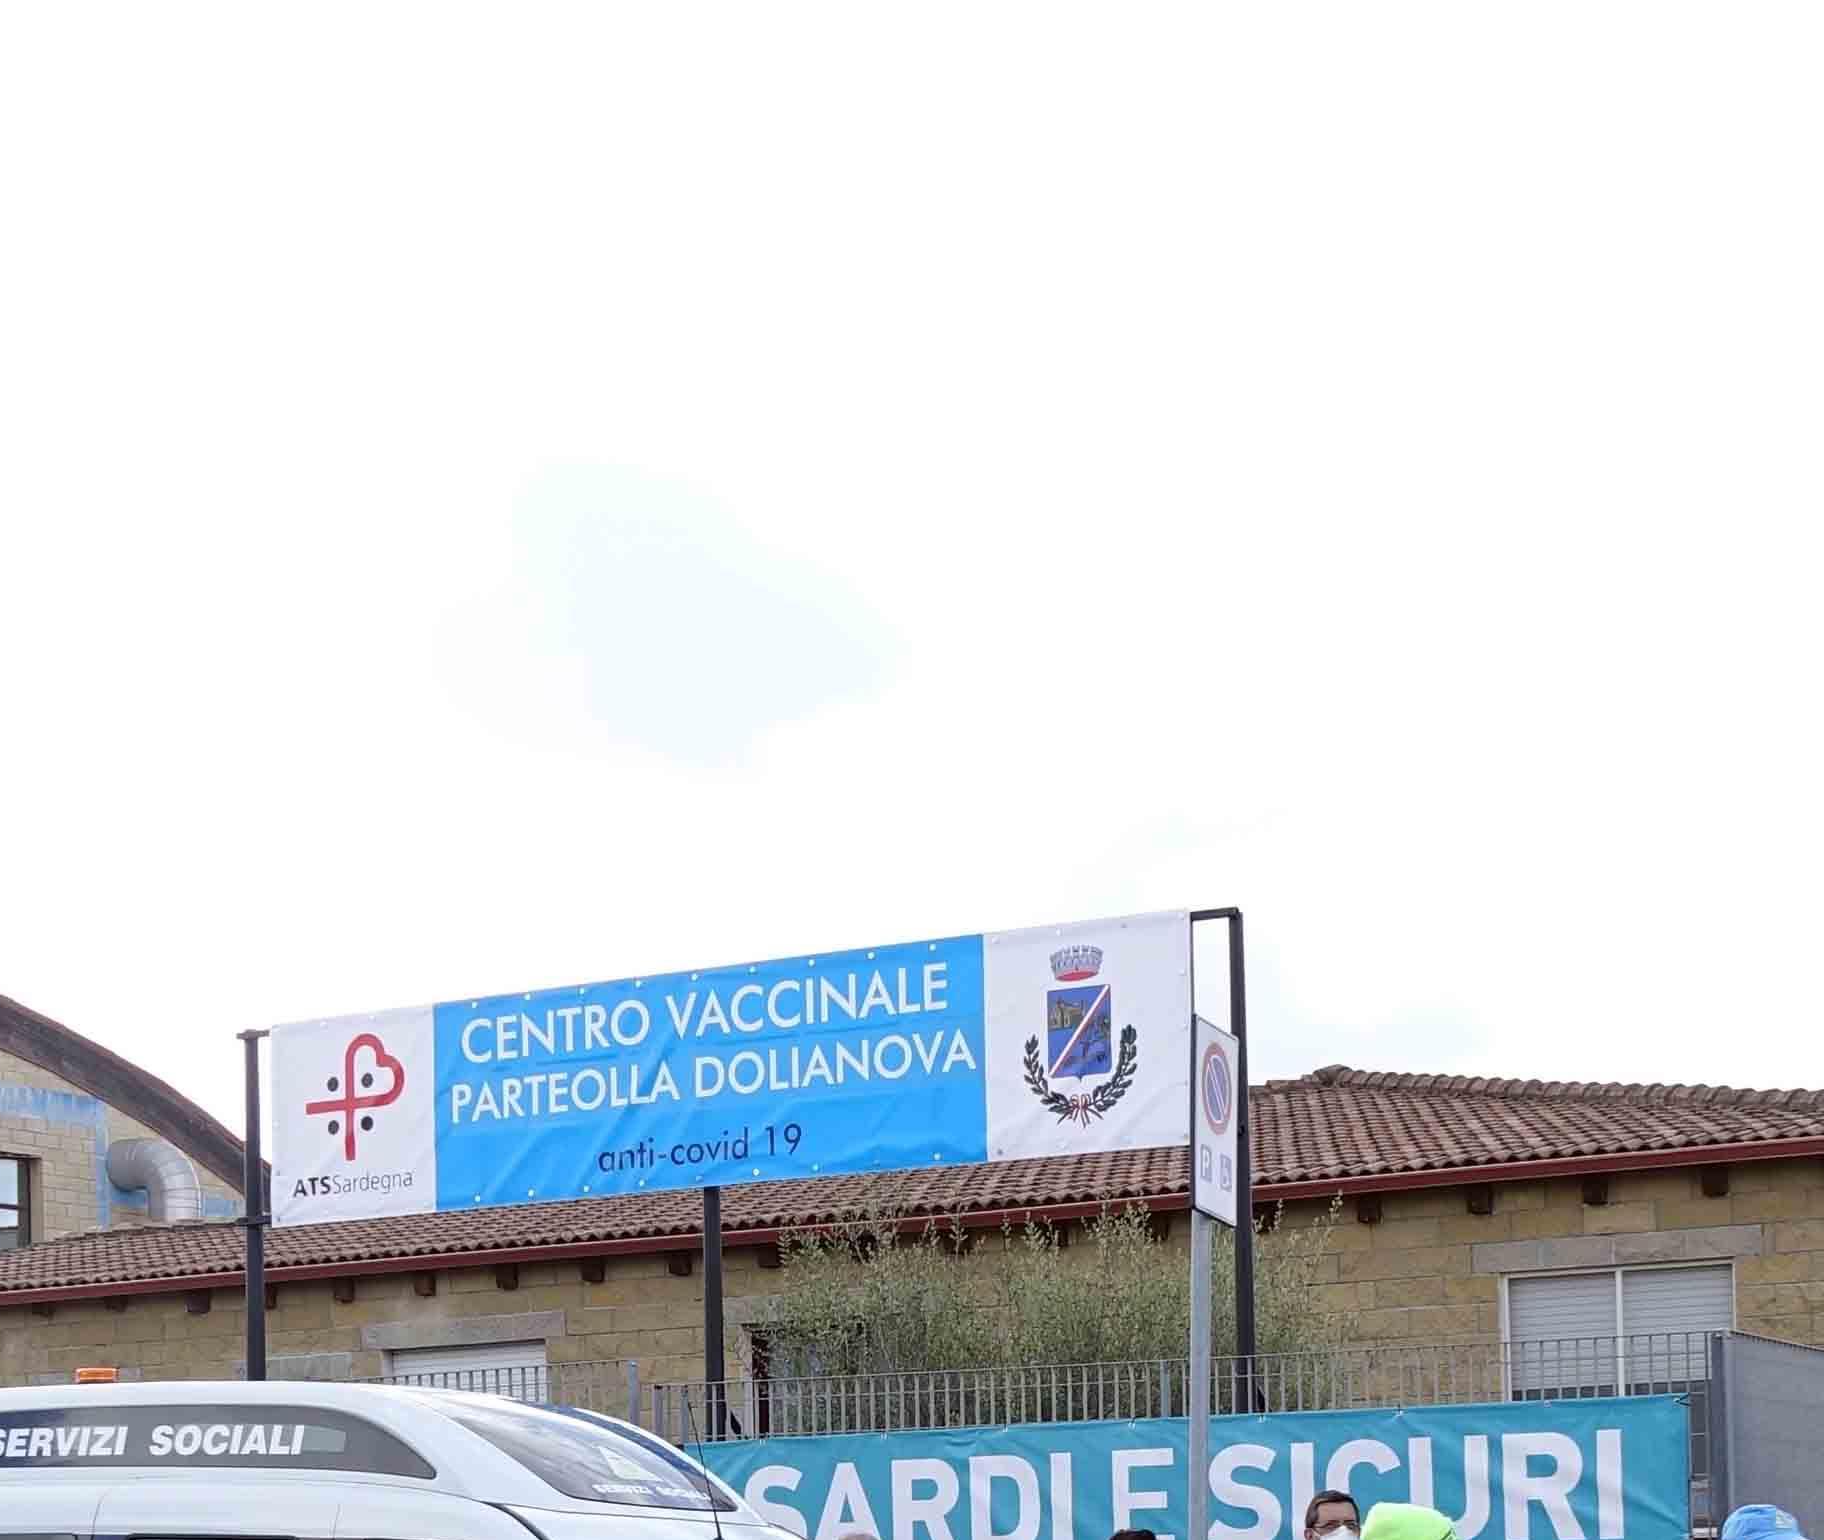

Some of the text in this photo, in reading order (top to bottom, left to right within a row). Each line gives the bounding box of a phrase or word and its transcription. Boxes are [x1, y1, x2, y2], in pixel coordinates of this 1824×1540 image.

[461, 962, 948, 1063] CENTRO VACCINALE
[451, 1028, 976, 1124] PARTEOLLA DOLIANOVA
[598, 1123, 802, 1172] anti-covid 19
[149, 1424, 305, 1456] SOCIALI
